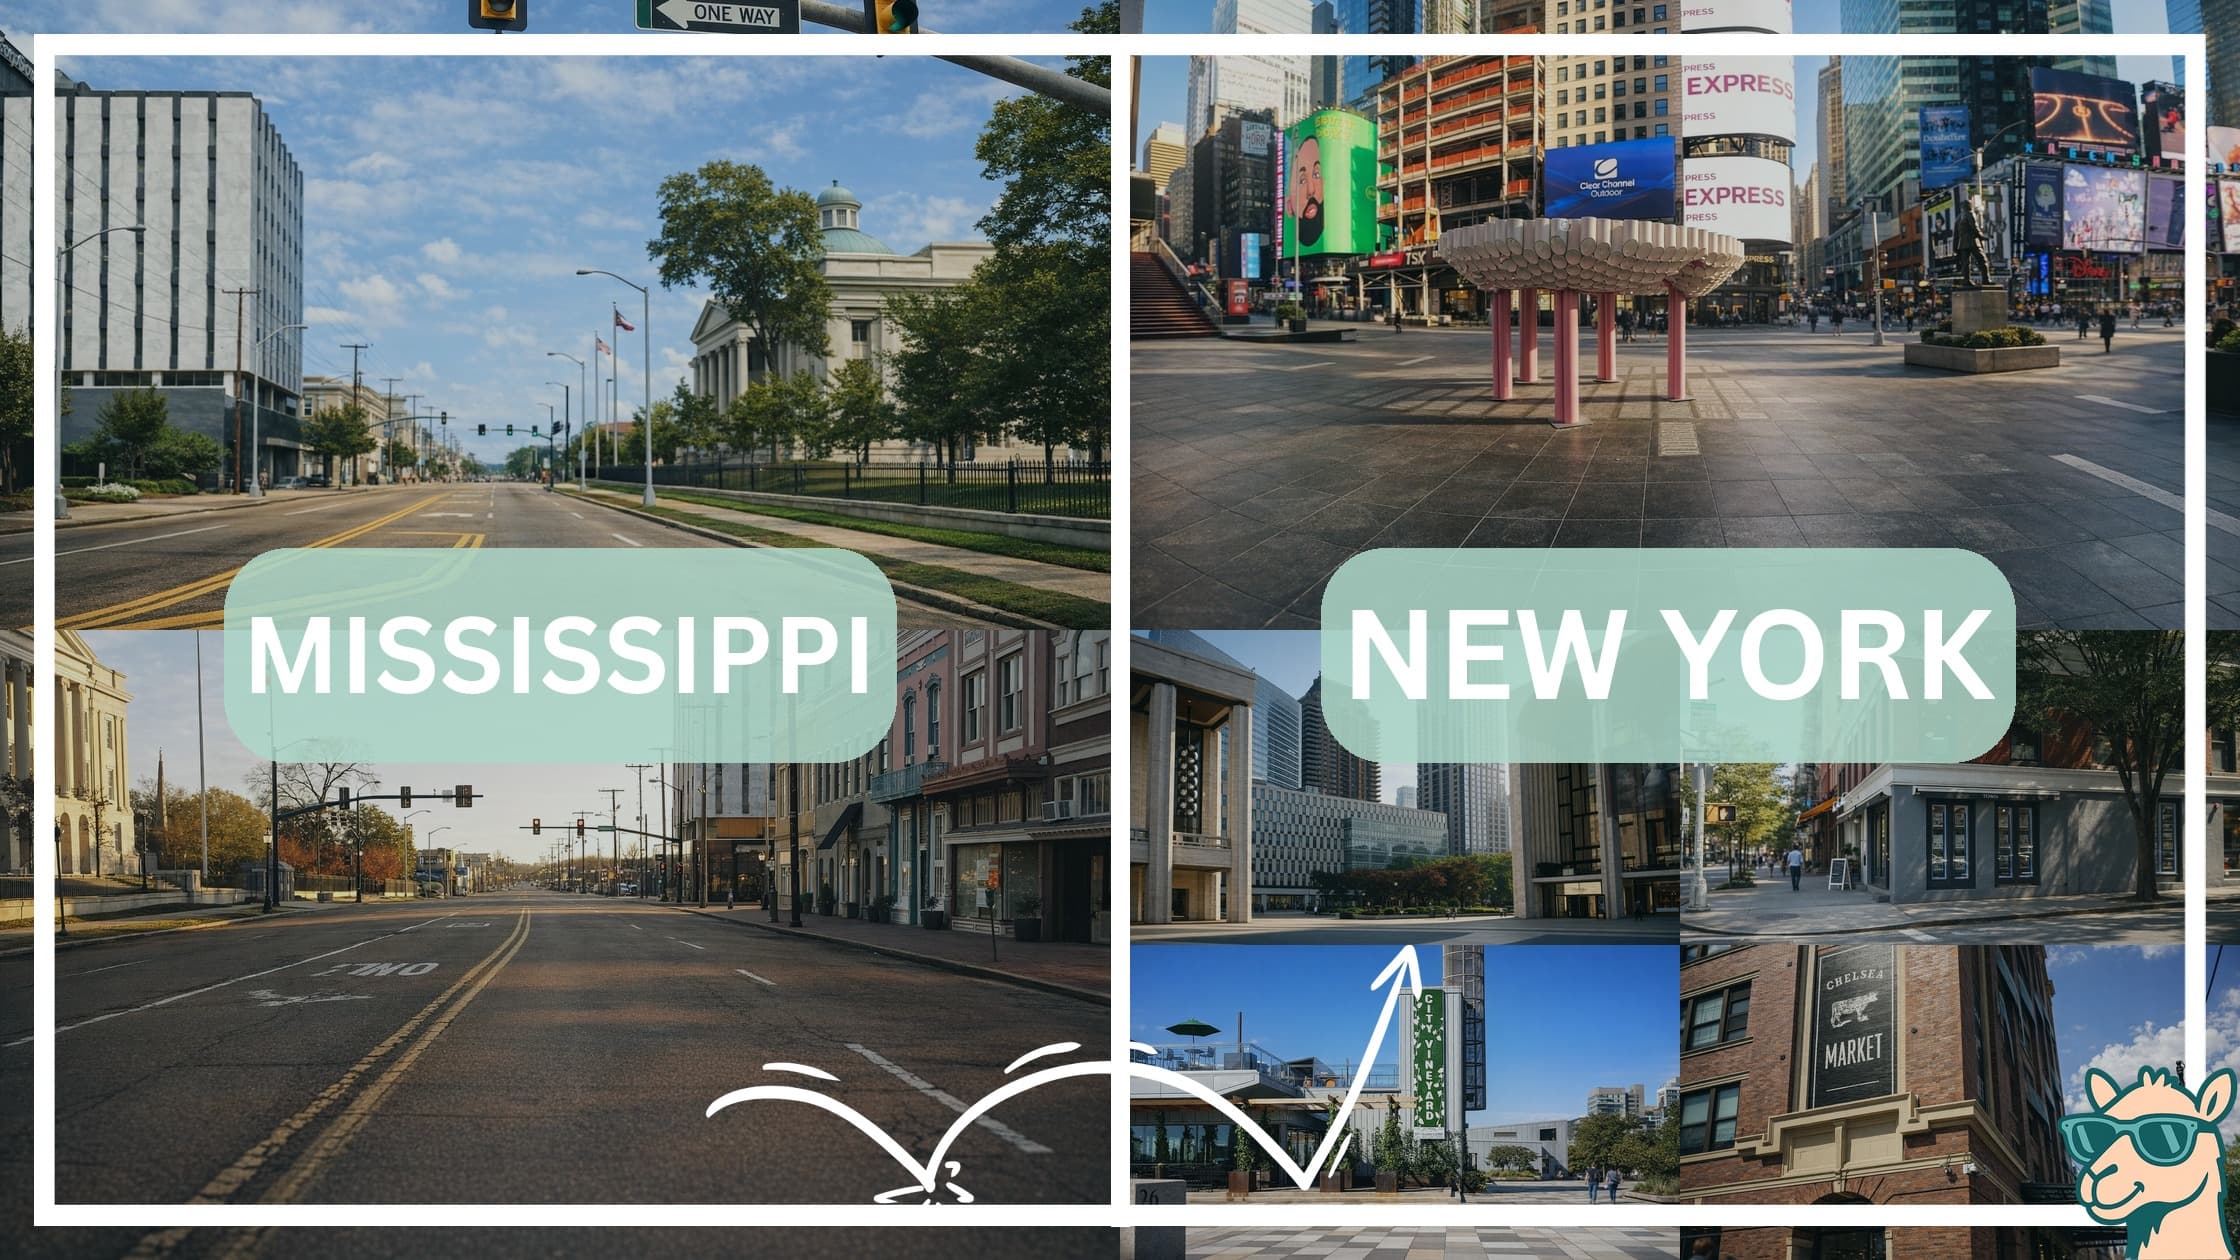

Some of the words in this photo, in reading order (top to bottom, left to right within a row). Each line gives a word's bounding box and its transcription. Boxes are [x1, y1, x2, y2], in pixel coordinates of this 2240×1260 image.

[694, 4, 733, 22] ONE
[739, 7, 776, 25] WAY
[1682, 63, 1716, 73] PRESS
[1687, 74, 1793, 101] EXPRESS
[1579, 182, 1600, 190] Clear
[1601, 178, 1635, 189] Channel
[1685, 173, 1717, 182] PRESS
[1590, 189, 1623, 198] Outdoor
[1685, 186, 1785, 207] EXPRESS
[1686, 213, 1718, 222] PRESS
[1405, 251, 1427, 265] TSX
[1825, 968, 1884, 991] CHELSEA
[1424, 994, 1434, 1034] CITY
[1824, 1032, 1884, 1070] MARKET
[1424, 1039, 1435, 1121] VINEYARD
